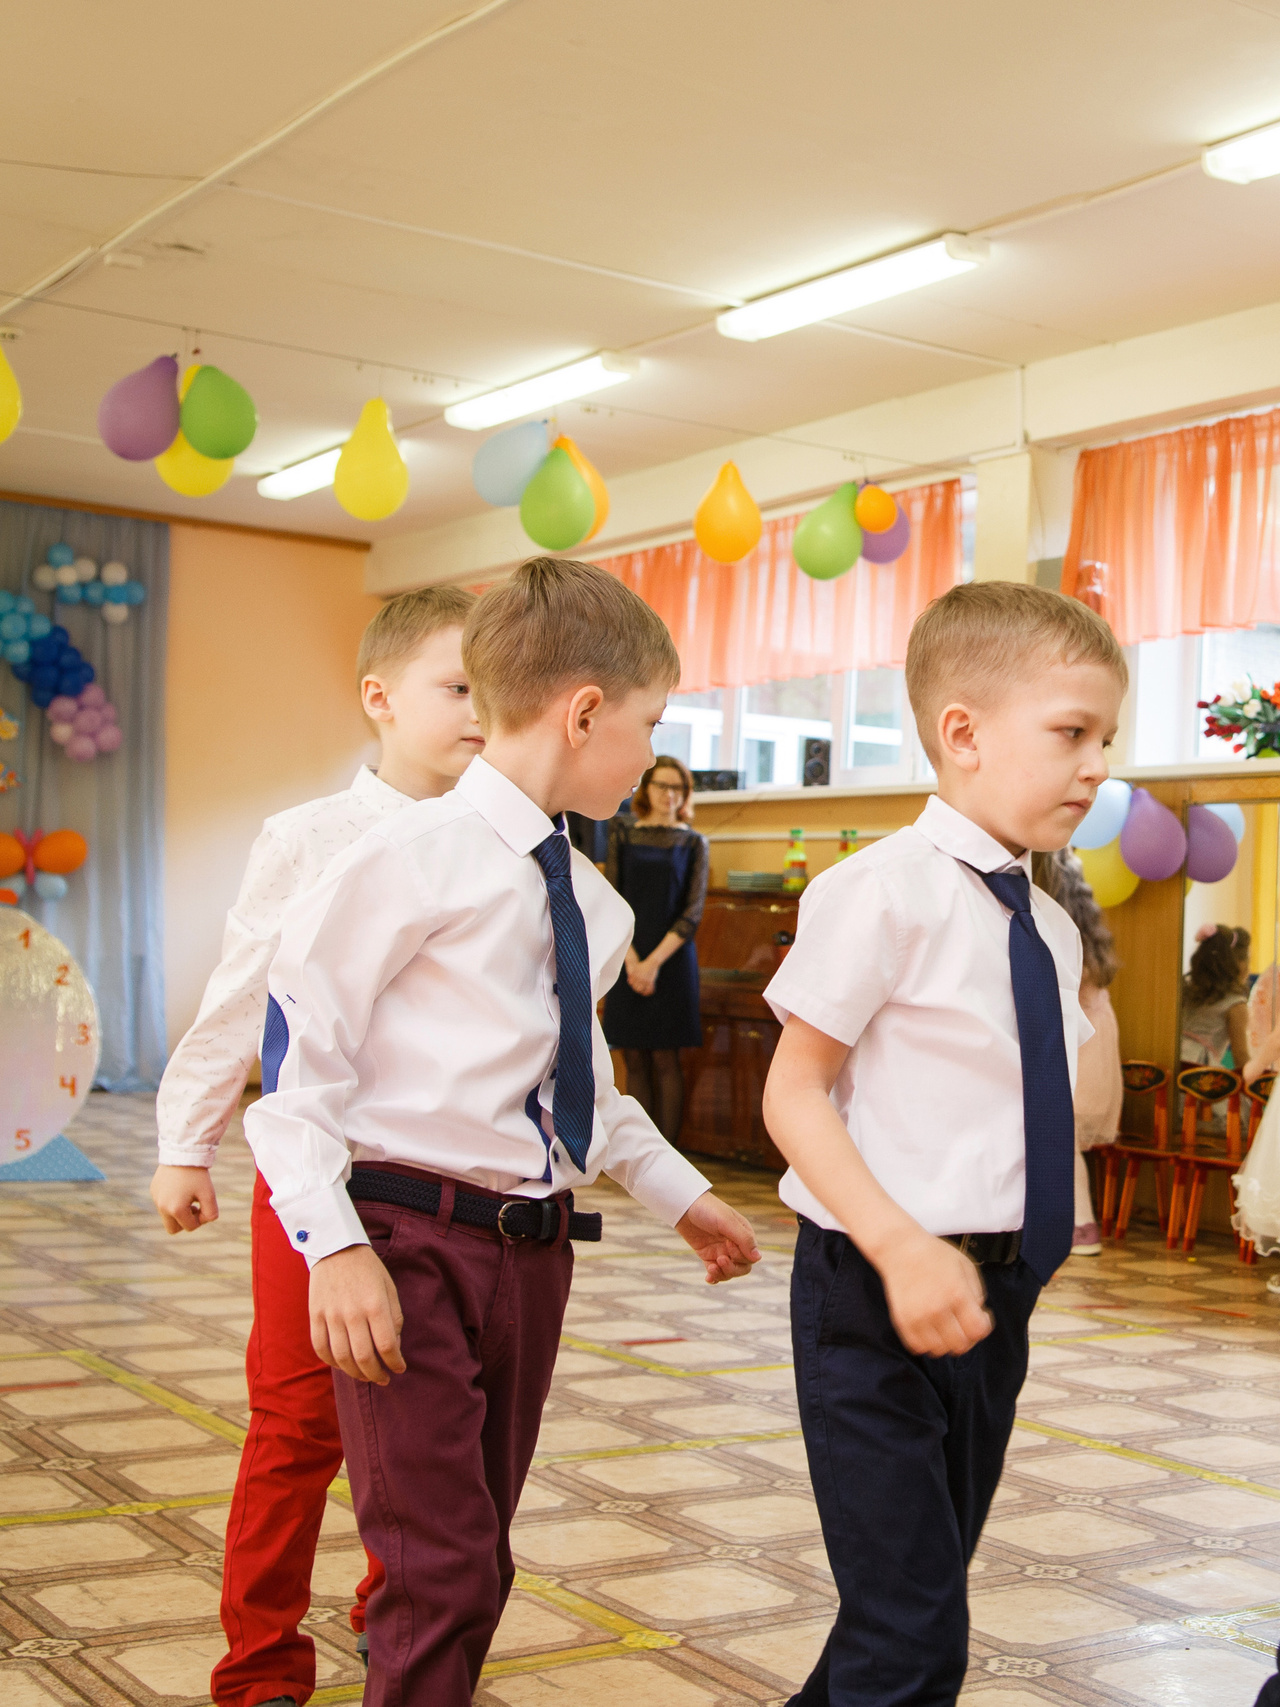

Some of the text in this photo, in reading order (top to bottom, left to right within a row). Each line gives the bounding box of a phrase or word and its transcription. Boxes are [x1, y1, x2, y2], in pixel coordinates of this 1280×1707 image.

[19, 928, 31, 949] 1
[55, 964, 70, 985] 2
[75, 1023, 90, 1045] 3
[59, 1074, 78, 1098] 4
[15, 1129, 31, 1150] 5
